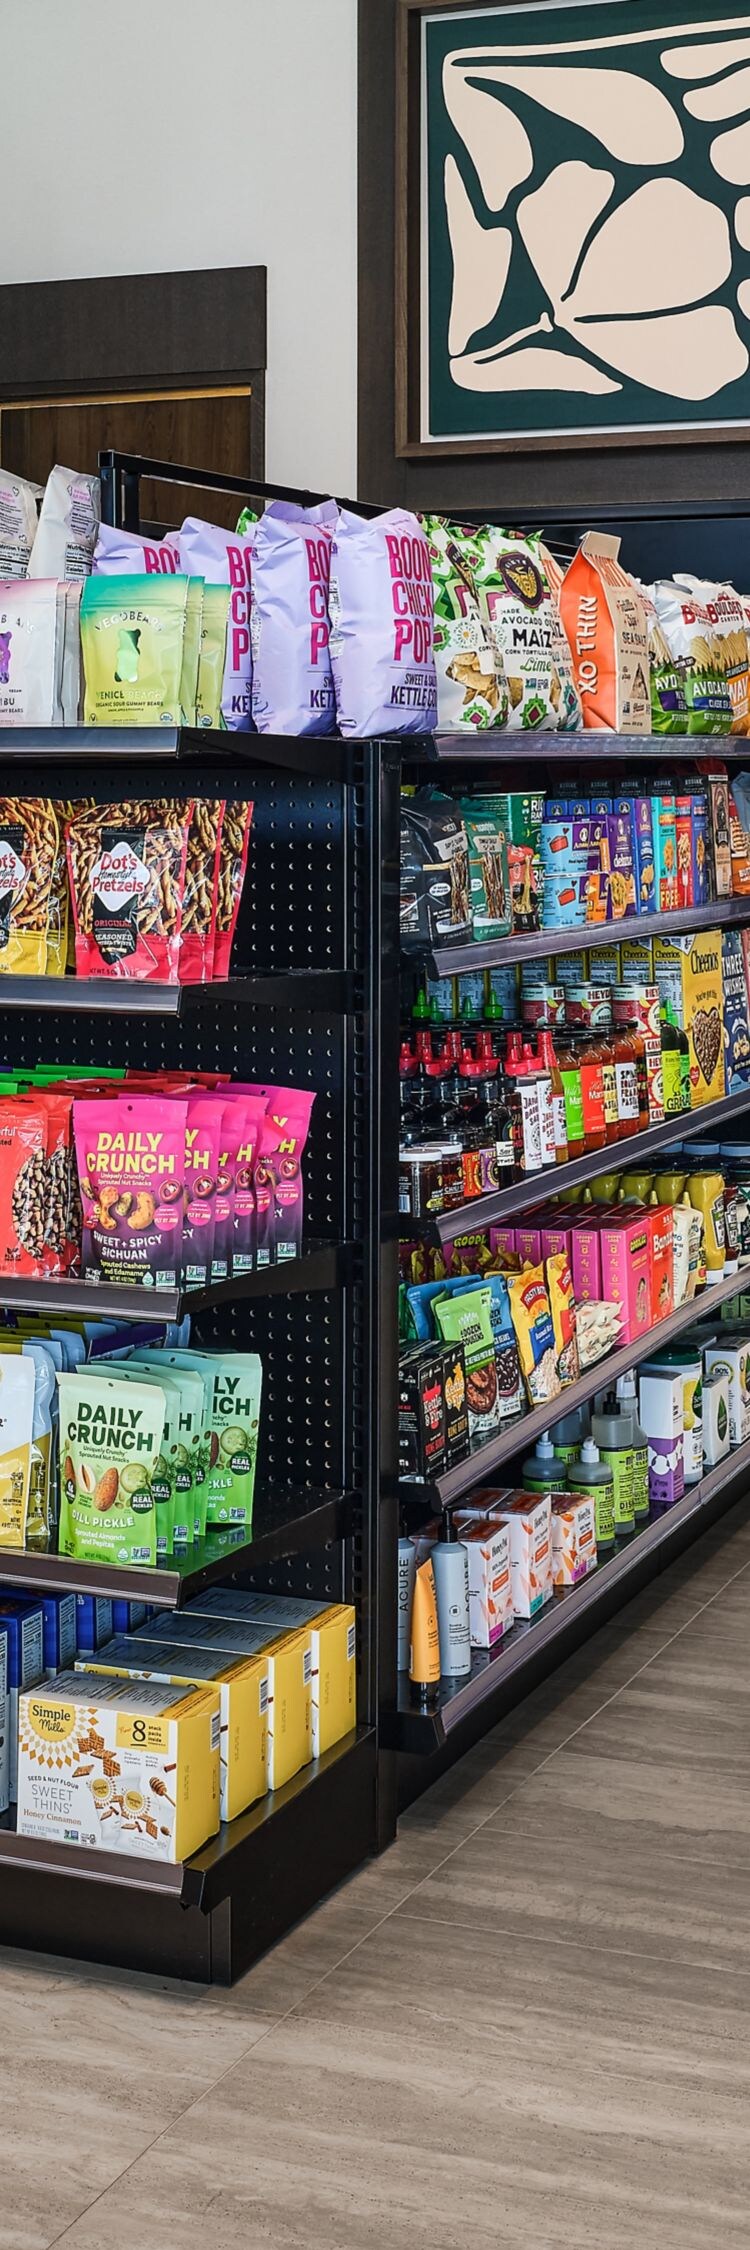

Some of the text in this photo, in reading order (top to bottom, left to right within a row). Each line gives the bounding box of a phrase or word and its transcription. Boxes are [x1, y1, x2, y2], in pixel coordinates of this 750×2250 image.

[501, 617, 543, 626] AVOCADO
[576, 595, 598, 655] THIN
[404, 673, 423, 686] SWEET
[96, 691, 124, 699] VENICE
[391, 685, 427, 706] KETTLE
[101, 853, 138, 870] Dot's
[92, 876, 145, 894] Pretzels
[691, 950, 718, 974] Cheerios
[722, 953, 743, 977] THREE
[724, 976, 744, 996] WISHES
[97, 1132, 163, 1153] DAILY
[86, 1153, 175, 1174] CRUNCH
[97, 1179, 119, 1187] Sprouted
[93, 1230, 120, 1246] SWEET
[129, 1234, 162, 1246] SPICY
[454, 1234, 488, 1248] GOODL
[101, 1247, 147, 1259] SICHUAN
[113, 1268, 144, 1277] Edamame
[78, 1402, 143, 1429] DAILY
[67, 1422, 154, 1452] CRUNCH
[79, 1451, 99, 1459] Sprouted
[231, 1458, 250, 1466] REAL
[132, 1495, 152, 1503] REAL
[72, 1510, 135, 1528] DILL PICKLE
[93, 1539, 115, 1548] Pepitas
[97, 1532, 125, 1541] Almonds
[399, 1558, 409, 1612] ACURE
[32, 1705, 71, 1721] Simple
[39, 1719, 65, 1732] Mills
[132, 1720, 146, 1742] 8
[32, 1784, 73, 1801] SWEET
[60, 1780, 79, 1790] FLOUR
[33, 1797, 70, 1814] THINS
[24, 1808, 82, 1825] Honey Cinnamon
